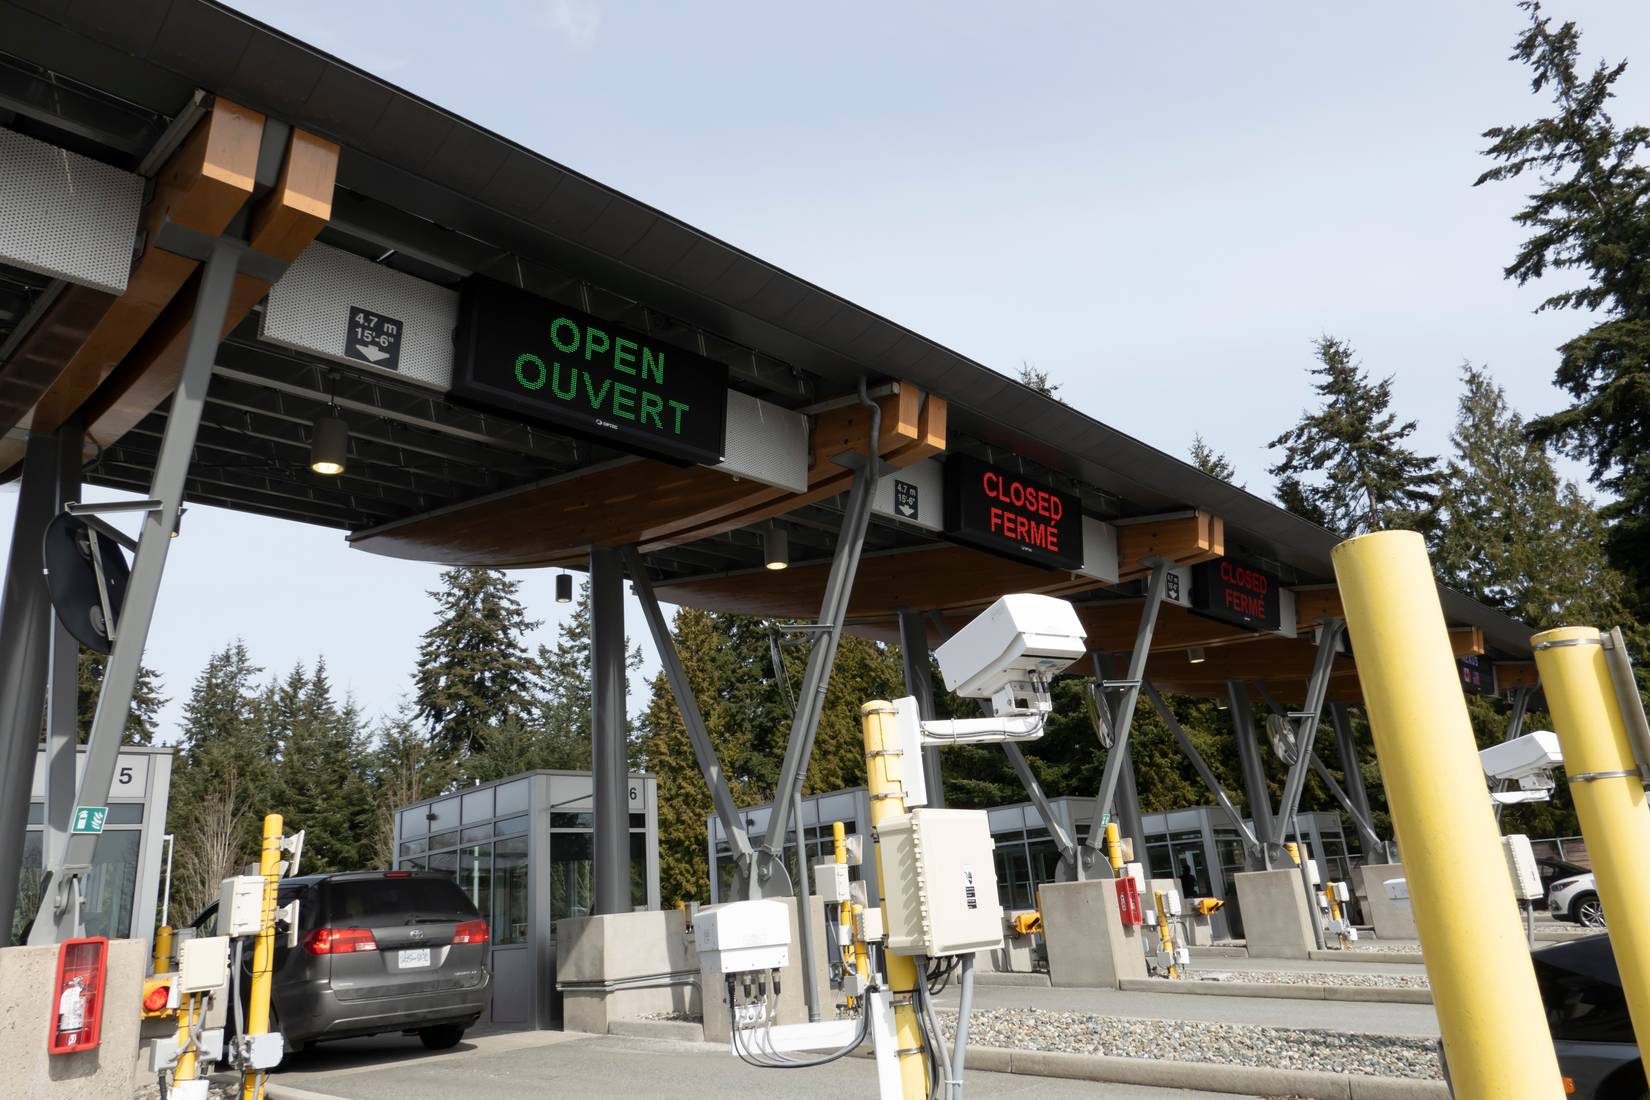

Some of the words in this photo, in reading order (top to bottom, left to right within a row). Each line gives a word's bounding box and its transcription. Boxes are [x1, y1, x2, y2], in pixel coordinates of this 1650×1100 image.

[355, 313, 378, 328] 4.7
[384, 322, 397, 335] m
[550, 317, 665, 385] OPEN
[515, 353, 690, 435] OUVERT
[983, 471, 1063, 521] CLOSED
[991, 506, 1059, 552] FERMÉ
[1220, 560, 1268, 594] CLOSED
[119, 767, 133, 785] 5
[629, 787, 638, 800] 6
